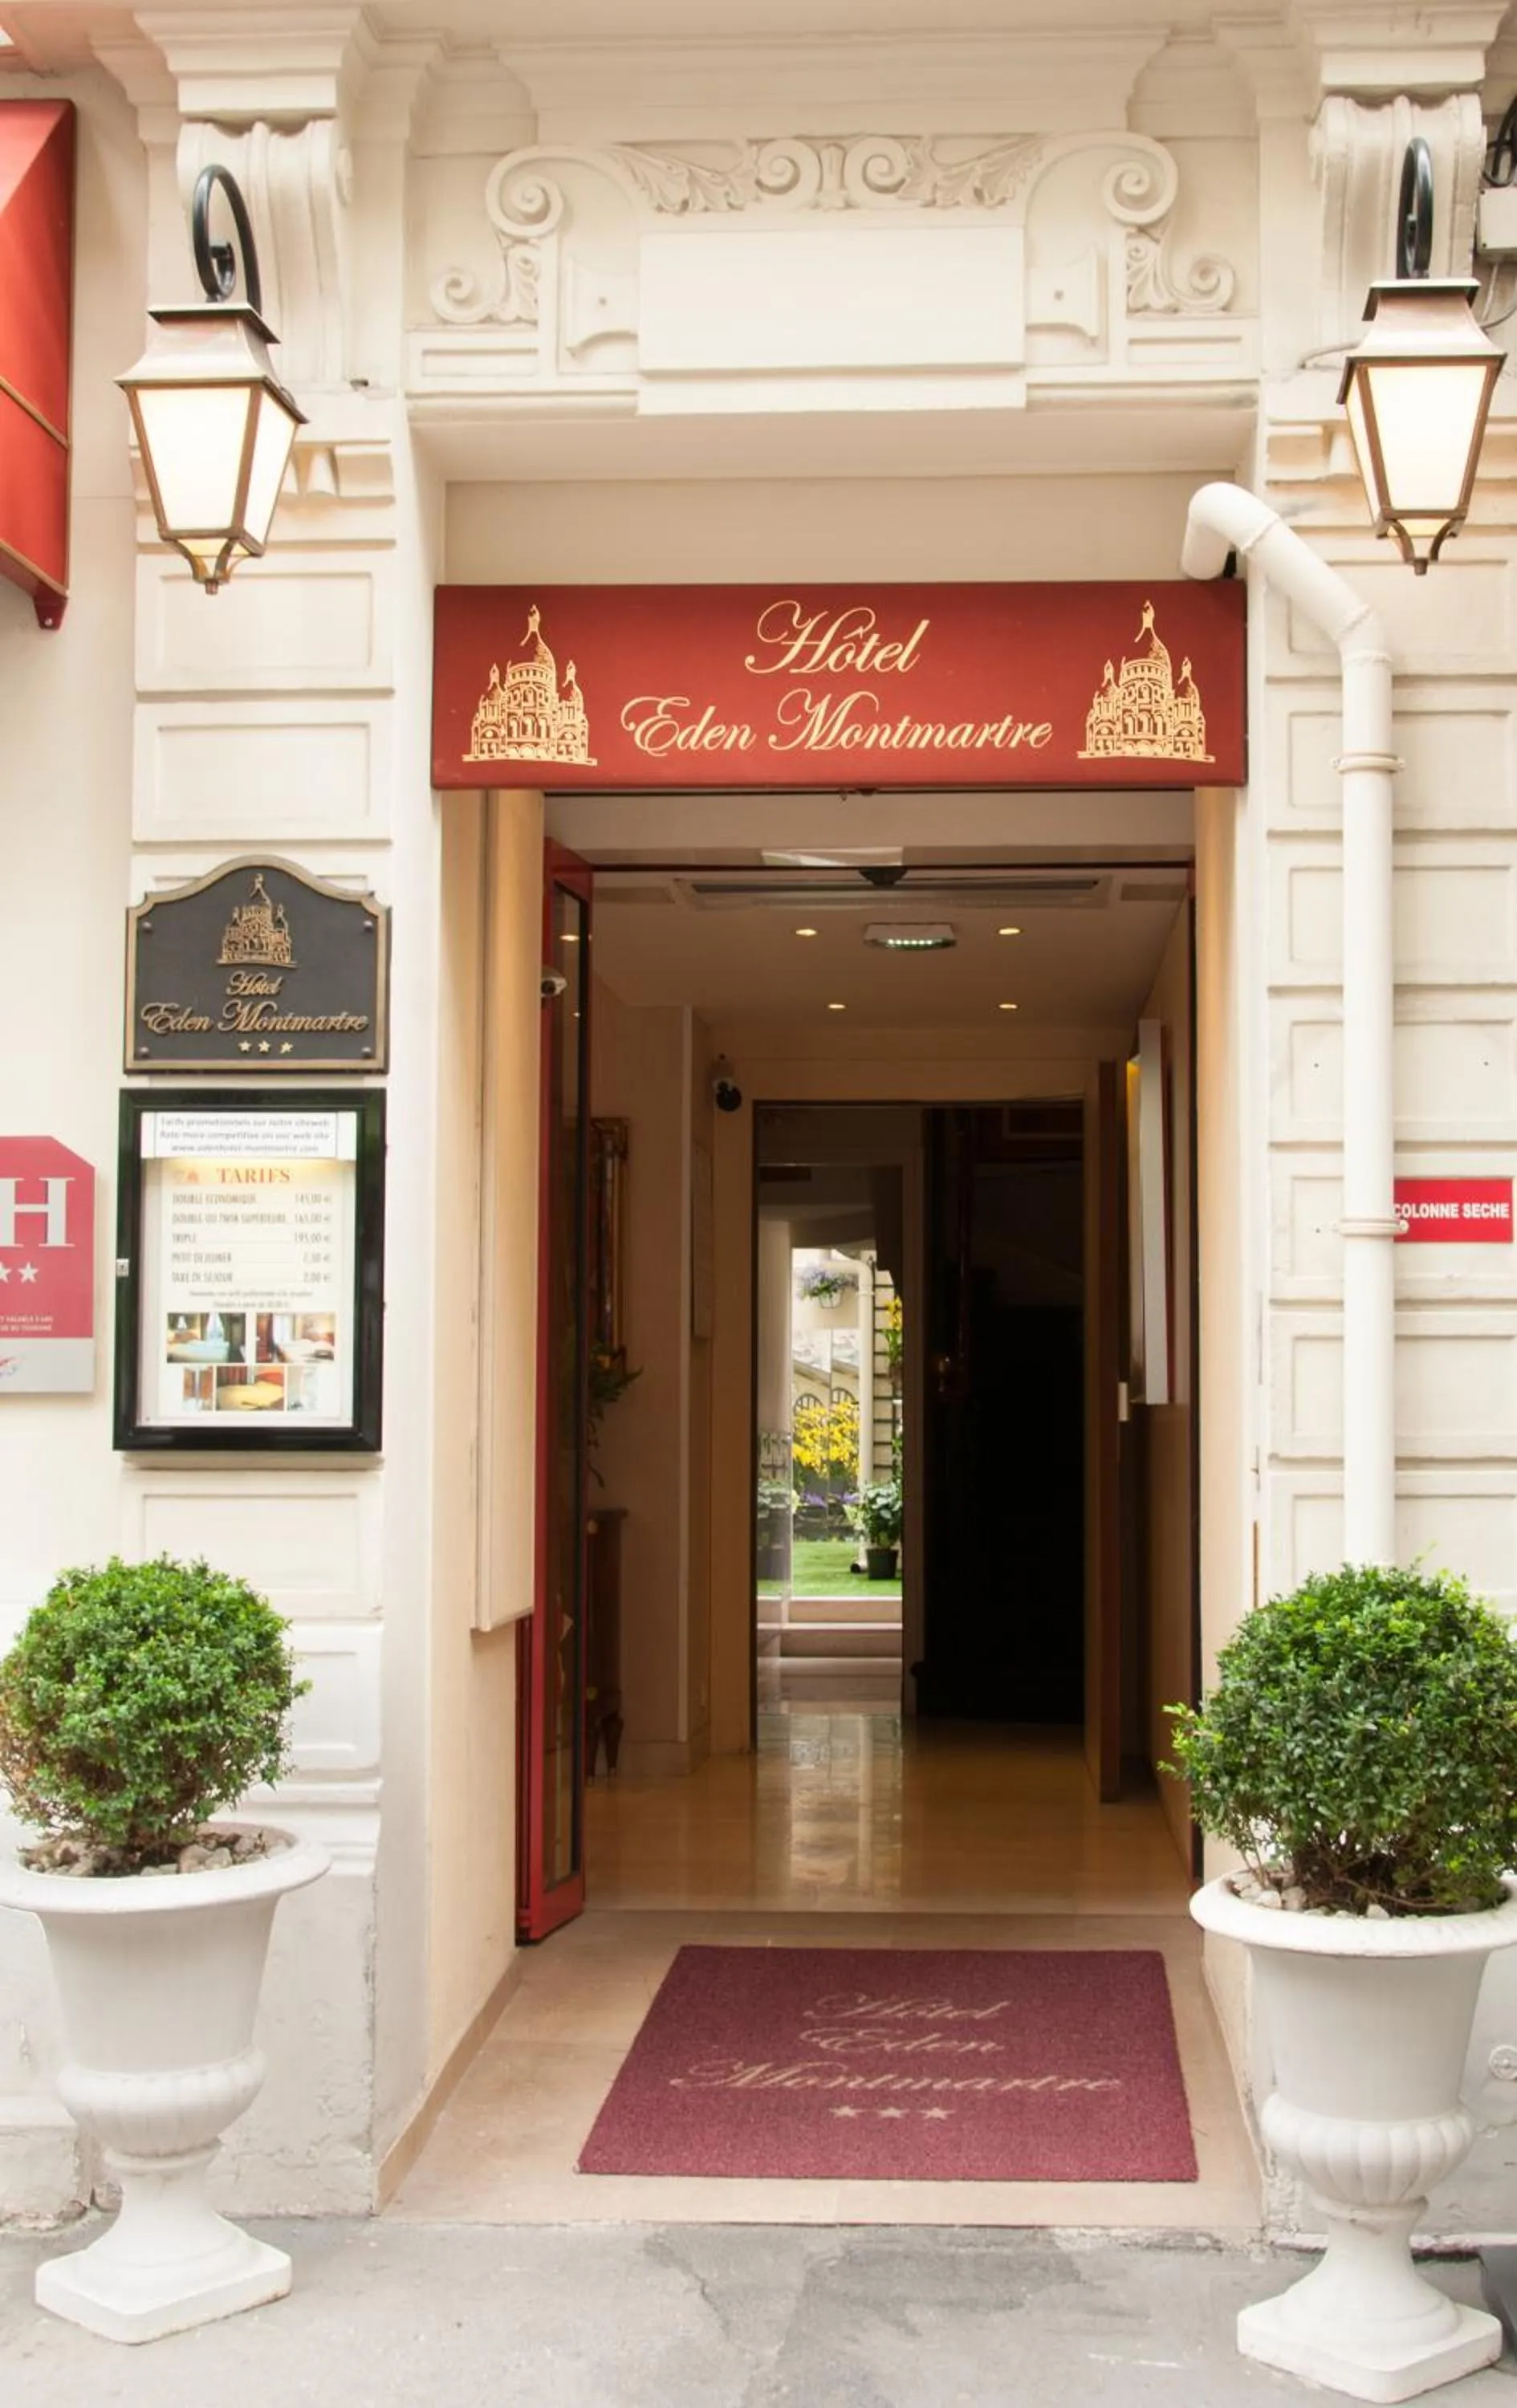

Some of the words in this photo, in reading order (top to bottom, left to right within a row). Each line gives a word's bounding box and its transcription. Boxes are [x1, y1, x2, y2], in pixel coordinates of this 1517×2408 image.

[745, 600, 930, 675] Hôtel
[620, 695, 758, 755] Eden
[767, 687, 1054, 753] Montmartre
[140, 1002, 214, 1035] Eden
[217, 1000, 369, 1033] Montmartre
[216, 1168, 291, 1184] TARIFS
[0, 1177, 75, 1247] H
[1393, 1202, 1459, 1218] COLONNE
[1462, 1202, 1510, 1218] SECHE
[798, 2028, 1007, 2053] Eden
[669, 2059, 1123, 2092] Montmartre
